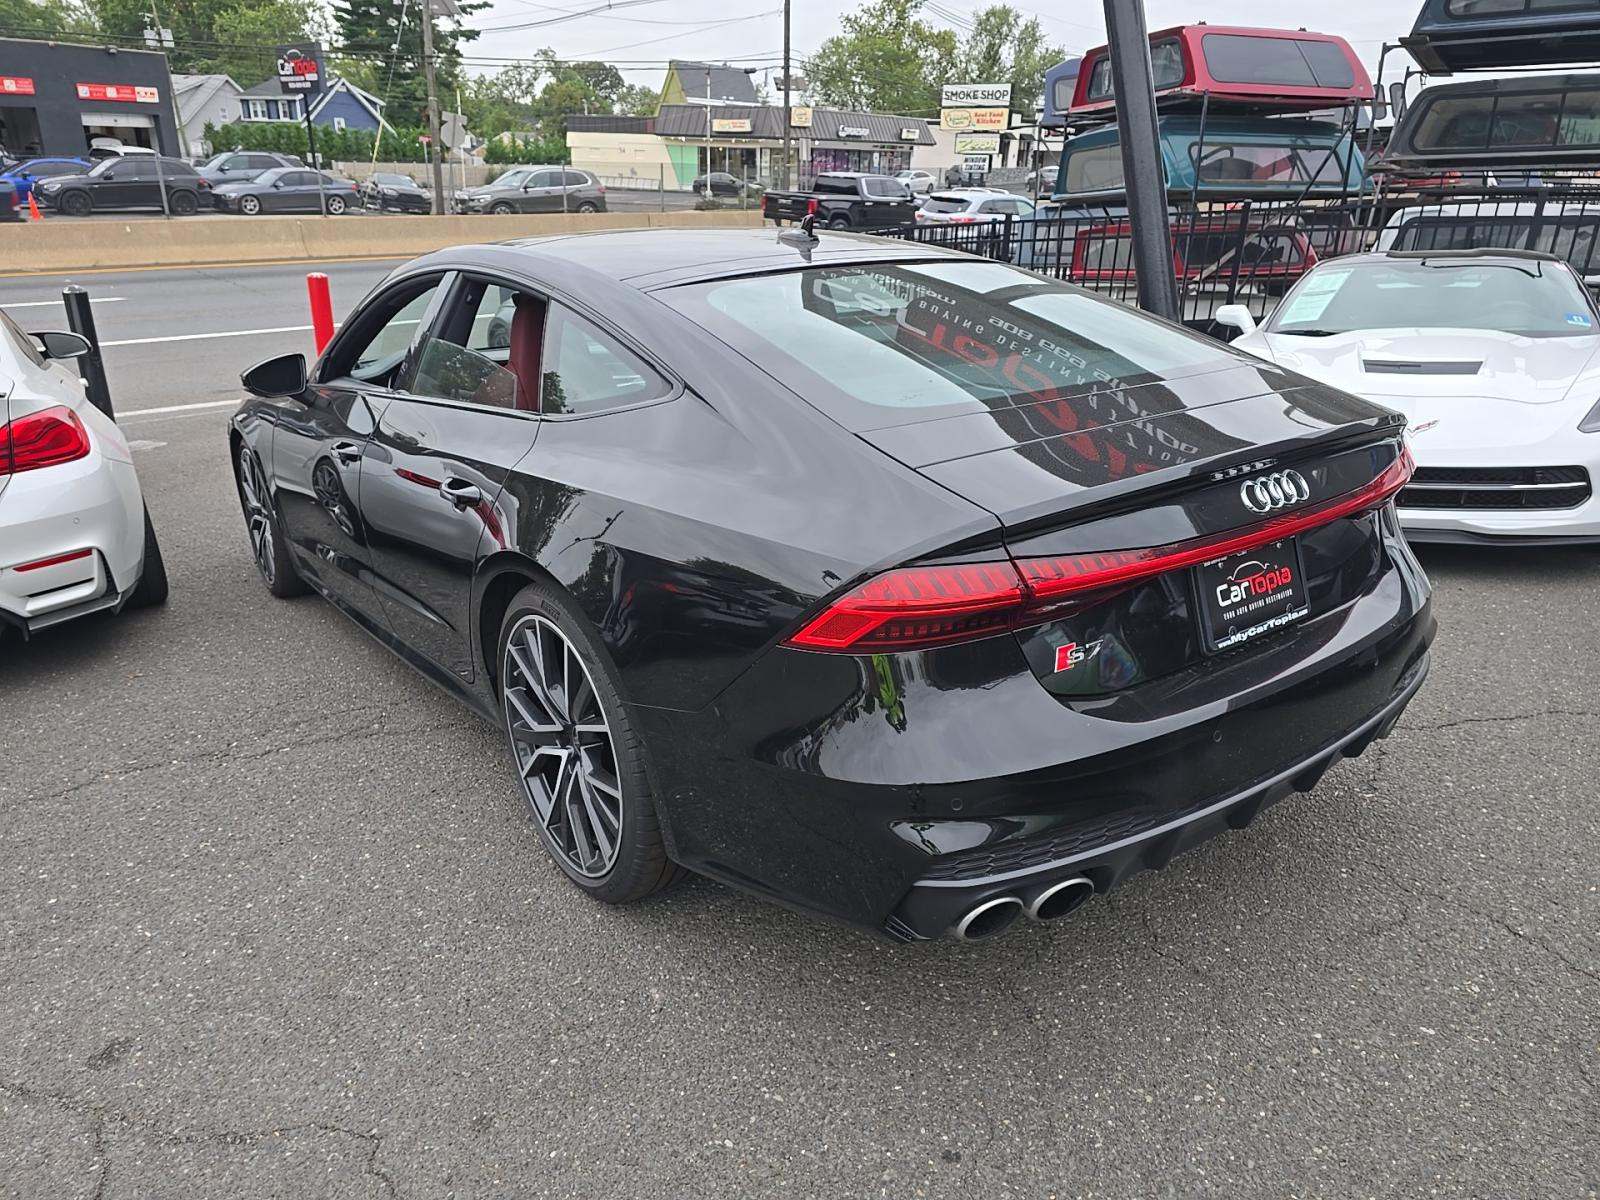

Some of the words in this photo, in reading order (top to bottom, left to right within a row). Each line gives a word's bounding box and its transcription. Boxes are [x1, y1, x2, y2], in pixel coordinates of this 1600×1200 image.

[944, 90, 979, 101] SMOKE
[981, 89, 1009, 101] SHOP
[964, 163, 986, 171] TINTING
[1216, 564, 1293, 607] CarTopia
[1064, 639, 1104, 665] S7
